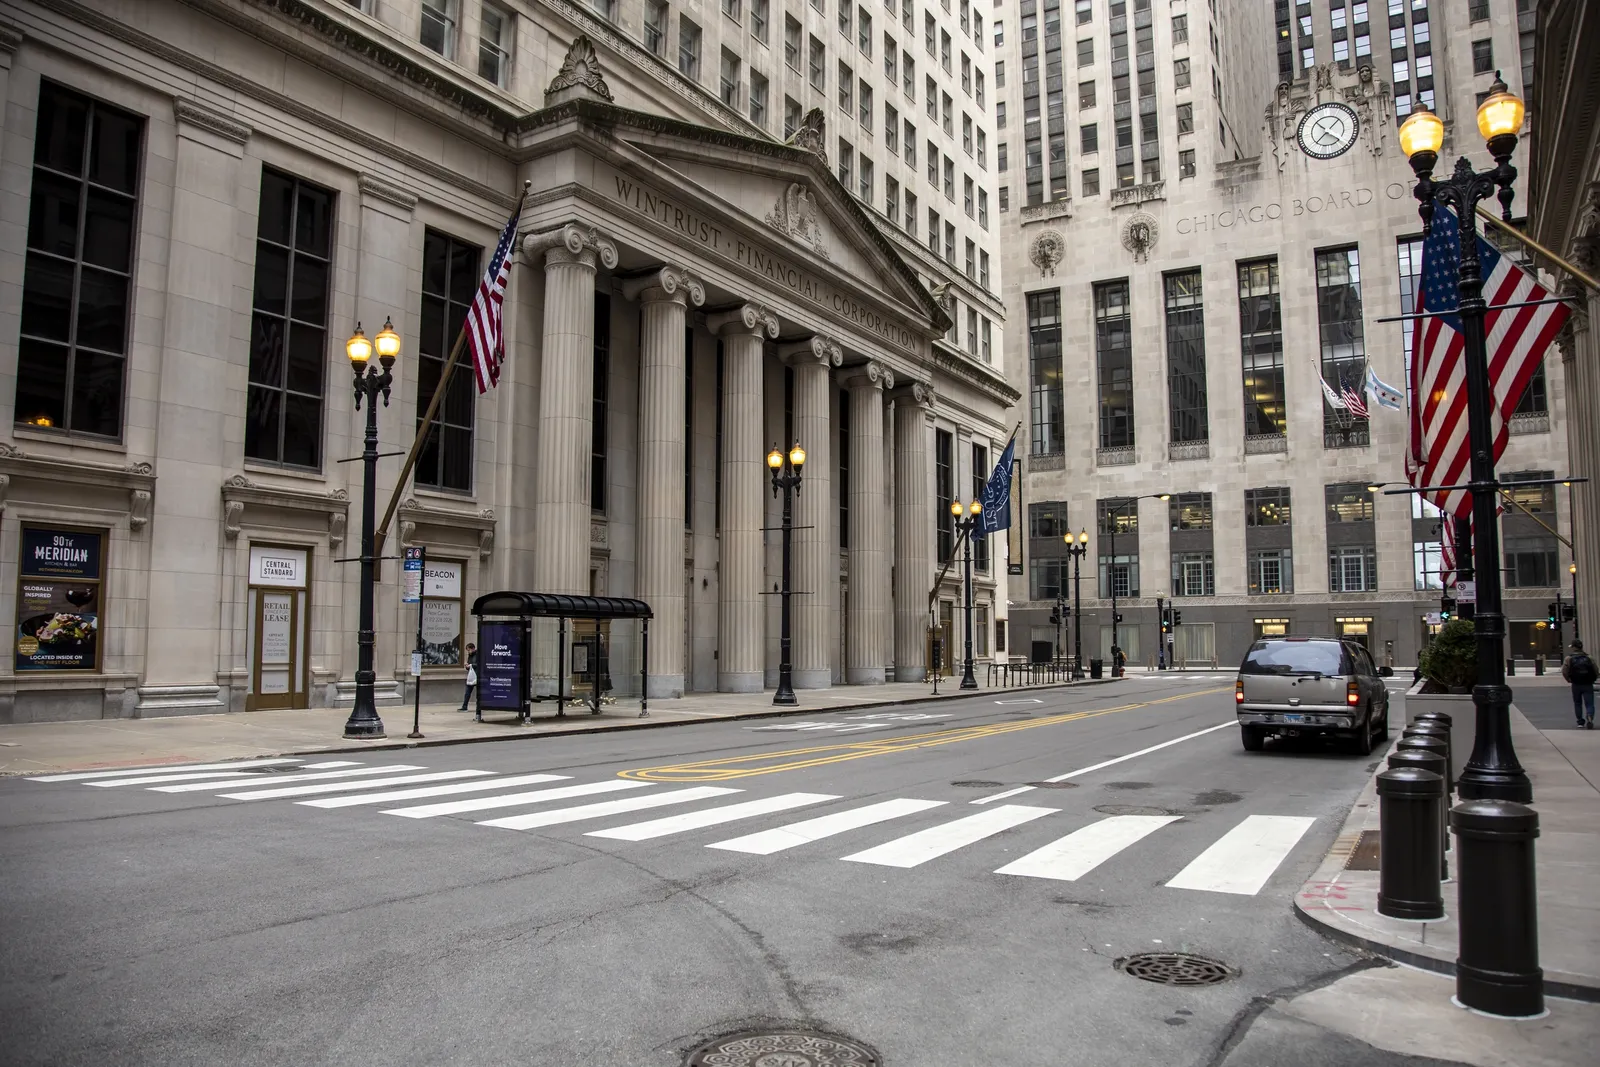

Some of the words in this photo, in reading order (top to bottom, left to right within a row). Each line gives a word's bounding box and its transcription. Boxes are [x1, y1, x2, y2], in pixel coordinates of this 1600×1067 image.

[1176, 203, 1282, 235] CHICAGO
[1293, 188, 1373, 217] BOARD
[614, 176, 722, 248] WINTRUST
[737, 241, 822, 302] FINANCIAL
[833, 293, 917, 351] CORPORATION
[35, 546, 88, 562] MERIDIAN
[266, 560, 291, 568] CENTRAL
[264, 568, 294, 576] STANDARD
[424, 570, 455, 578] BEACON
